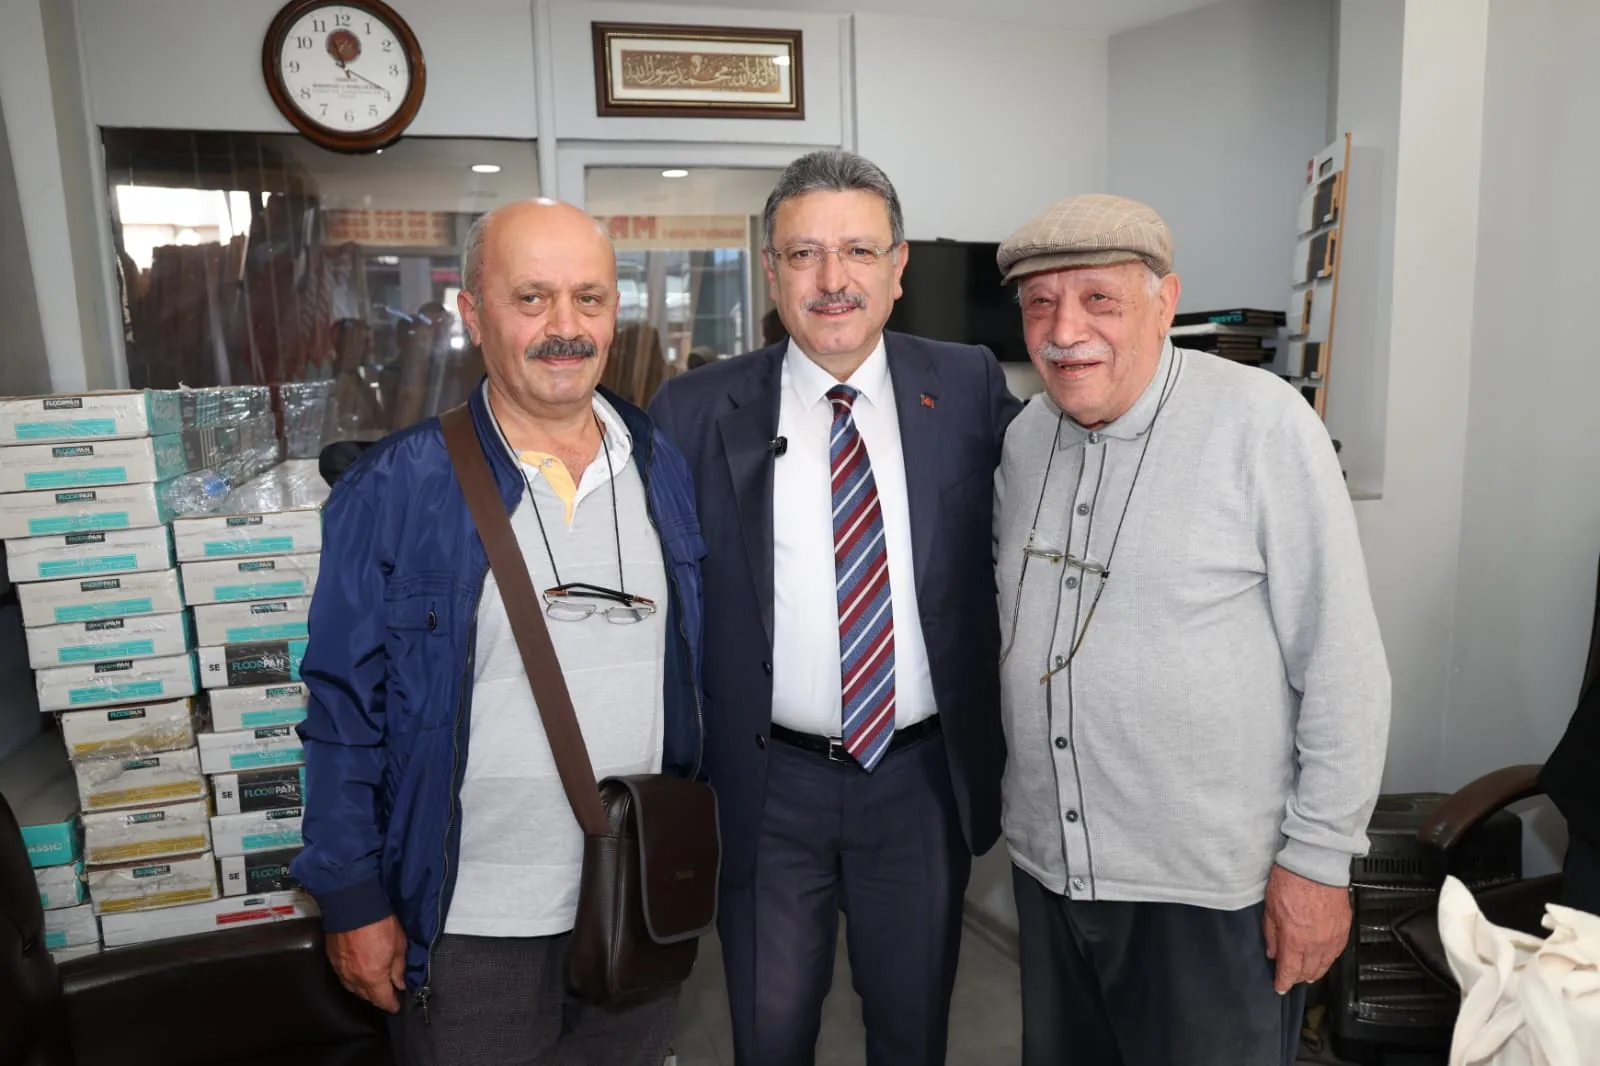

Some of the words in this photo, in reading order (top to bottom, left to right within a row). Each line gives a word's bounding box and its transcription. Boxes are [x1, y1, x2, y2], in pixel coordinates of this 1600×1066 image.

[312, 20, 326, 33] 11
[334, 14, 351, 27] 12
[364, 22, 371, 34] 1
[296, 36, 312, 49] 10
[381, 40, 392, 52] 2
[289, 61, 300, 73] 9
[389, 65, 399, 76] 3
[300, 87, 311, 100] 8
[383, 91, 391, 102] 4
[319, 104, 328, 116] 7
[368, 105, 378, 117] 5
[344, 111, 354, 123] 6
[208, 664, 221, 672] SE
[232, 658, 285, 671] FLOORPAN
[222, 791, 232, 799] SE
[244, 785, 296, 798] FLOORPAN
[229, 872, 240, 880] SE
